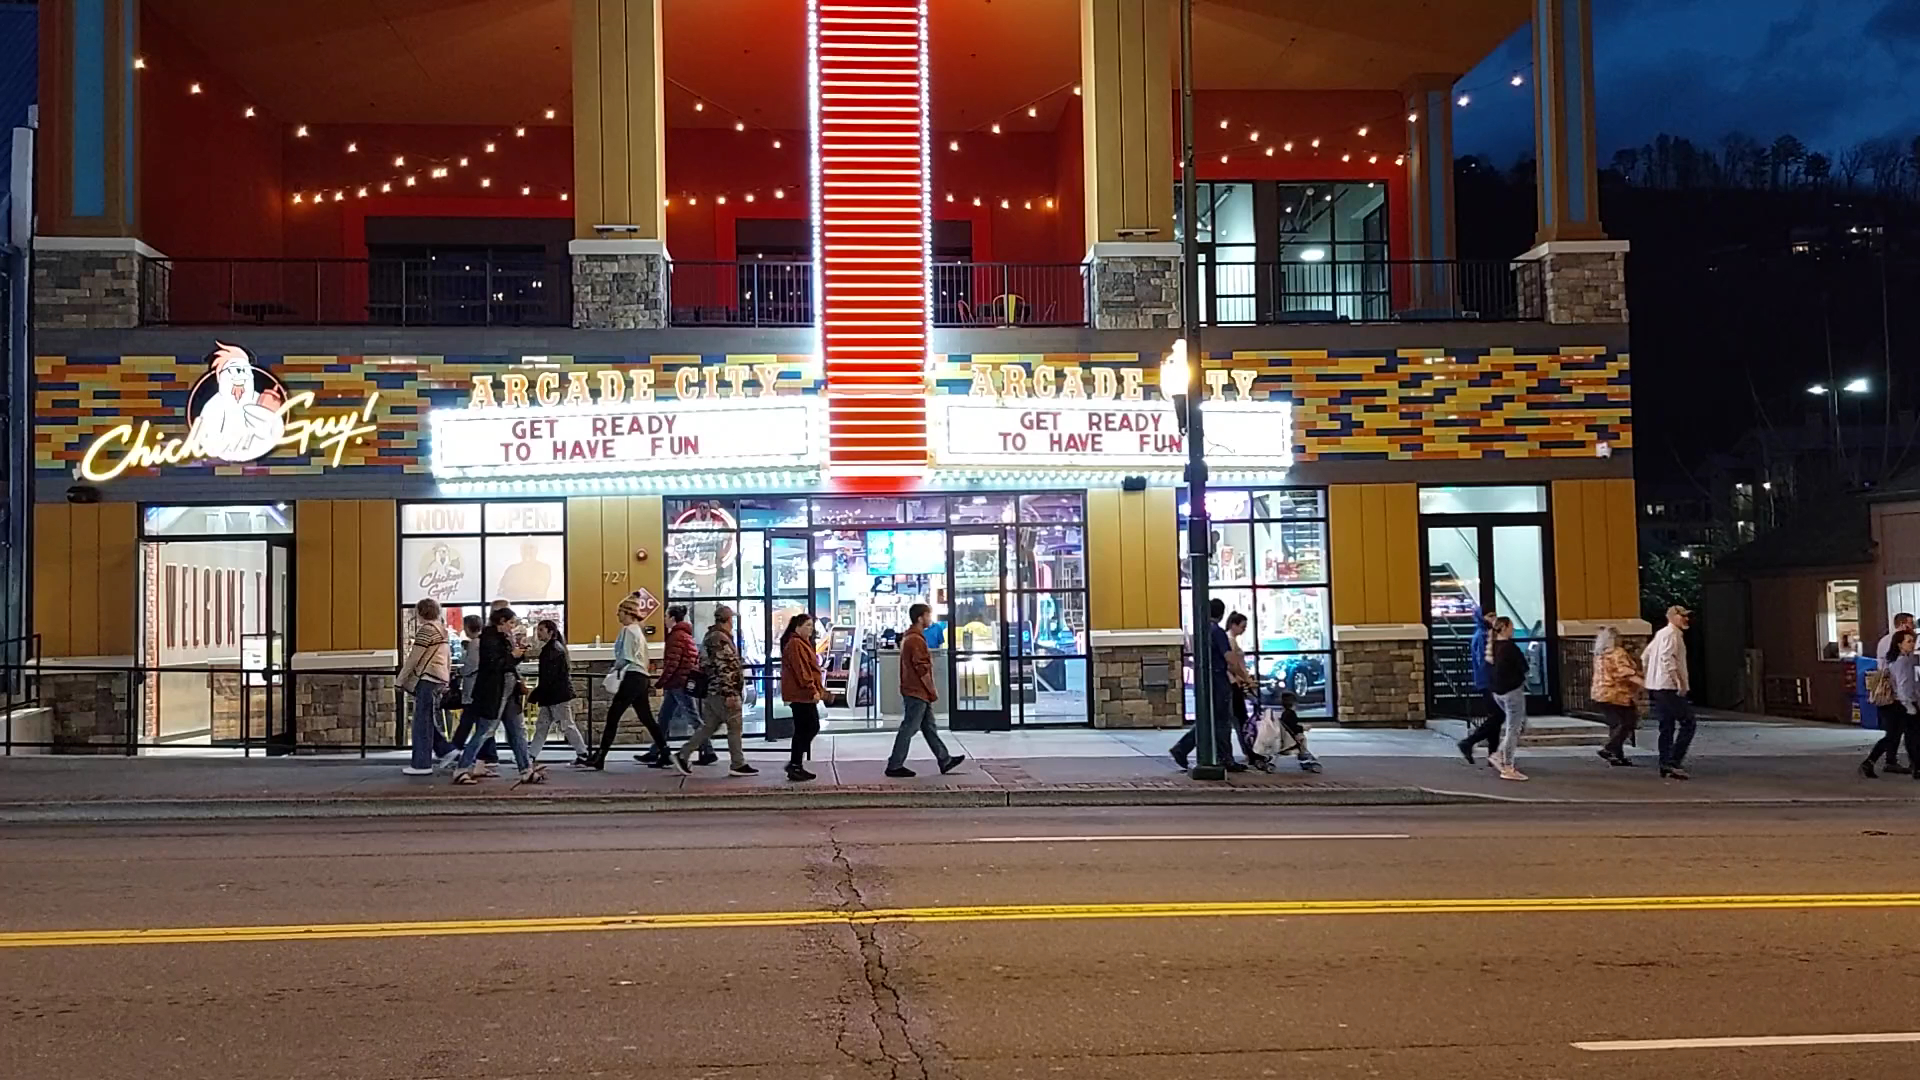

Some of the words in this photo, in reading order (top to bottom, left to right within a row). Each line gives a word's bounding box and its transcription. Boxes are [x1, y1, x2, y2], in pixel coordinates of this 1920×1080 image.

[468, 369, 655, 409] ARCADE
[675, 364, 782, 401] CITY
[969, 364, 1143, 401] ARCADE
[512, 419, 559, 439] GET
[592, 414, 677, 437] READY
[1020, 411, 1061, 431] GET
[1088, 412, 1162, 432] READY
[500, 442, 531, 462] TO
[552, 439, 616, 460] HAVE
[650, 435, 699, 456] FUN
[998, 432, 1027, 451] TO
[1050, 433, 1104, 452] HAVE
[1139, 434, 1183, 453] FUN
[416, 508, 465, 532] NOW
[603, 571, 628, 583] 727
